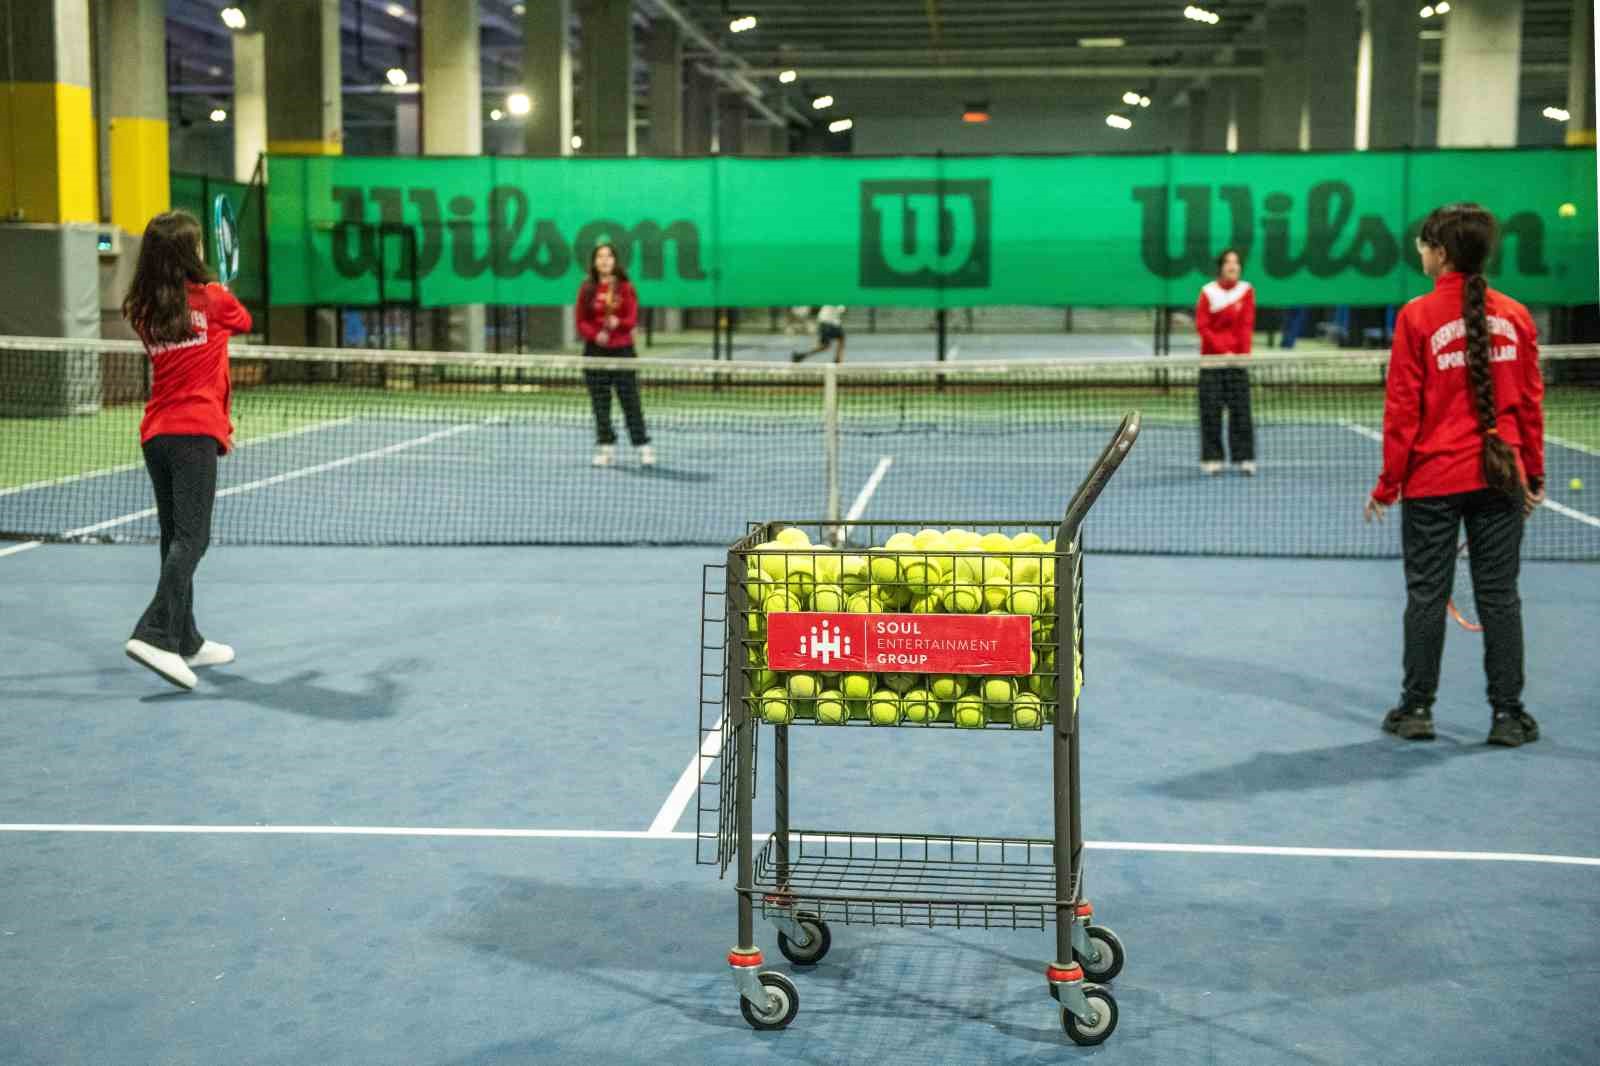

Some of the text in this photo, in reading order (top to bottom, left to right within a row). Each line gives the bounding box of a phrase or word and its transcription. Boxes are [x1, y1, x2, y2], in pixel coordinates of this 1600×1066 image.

[332, 184, 707, 280] Wilson
[877, 621, 921, 635] SOUL
[877, 638, 998, 651] ENTERTAINMENT
[877, 653, 928, 665] GROUP
